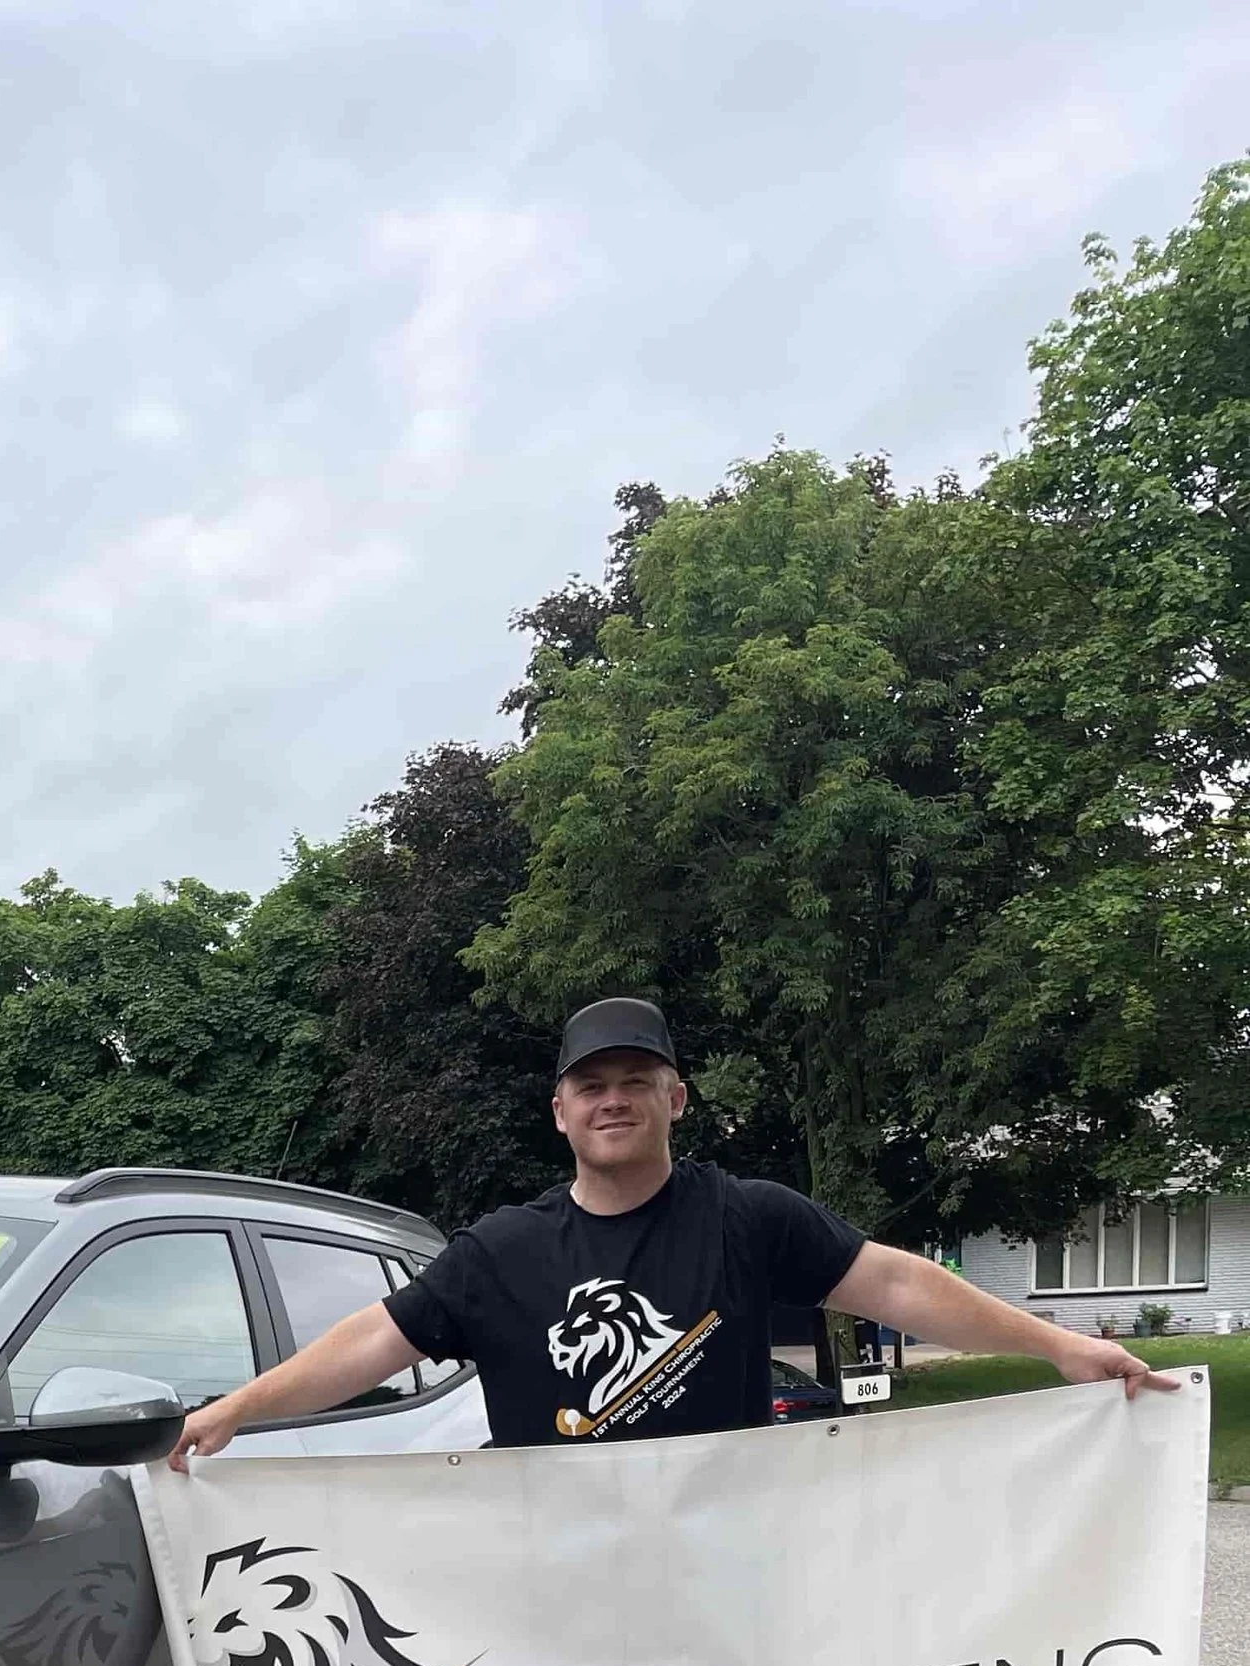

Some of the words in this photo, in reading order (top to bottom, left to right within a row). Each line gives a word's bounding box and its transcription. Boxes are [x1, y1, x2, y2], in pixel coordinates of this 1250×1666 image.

[661, 1385, 687, 1409] 2024
[857, 1382, 879, 1397] 806
[592, 1422, 609, 1438] 1ST
[642, 1372, 665, 1394] KING
[626, 1402, 650, 1425] GOLF
